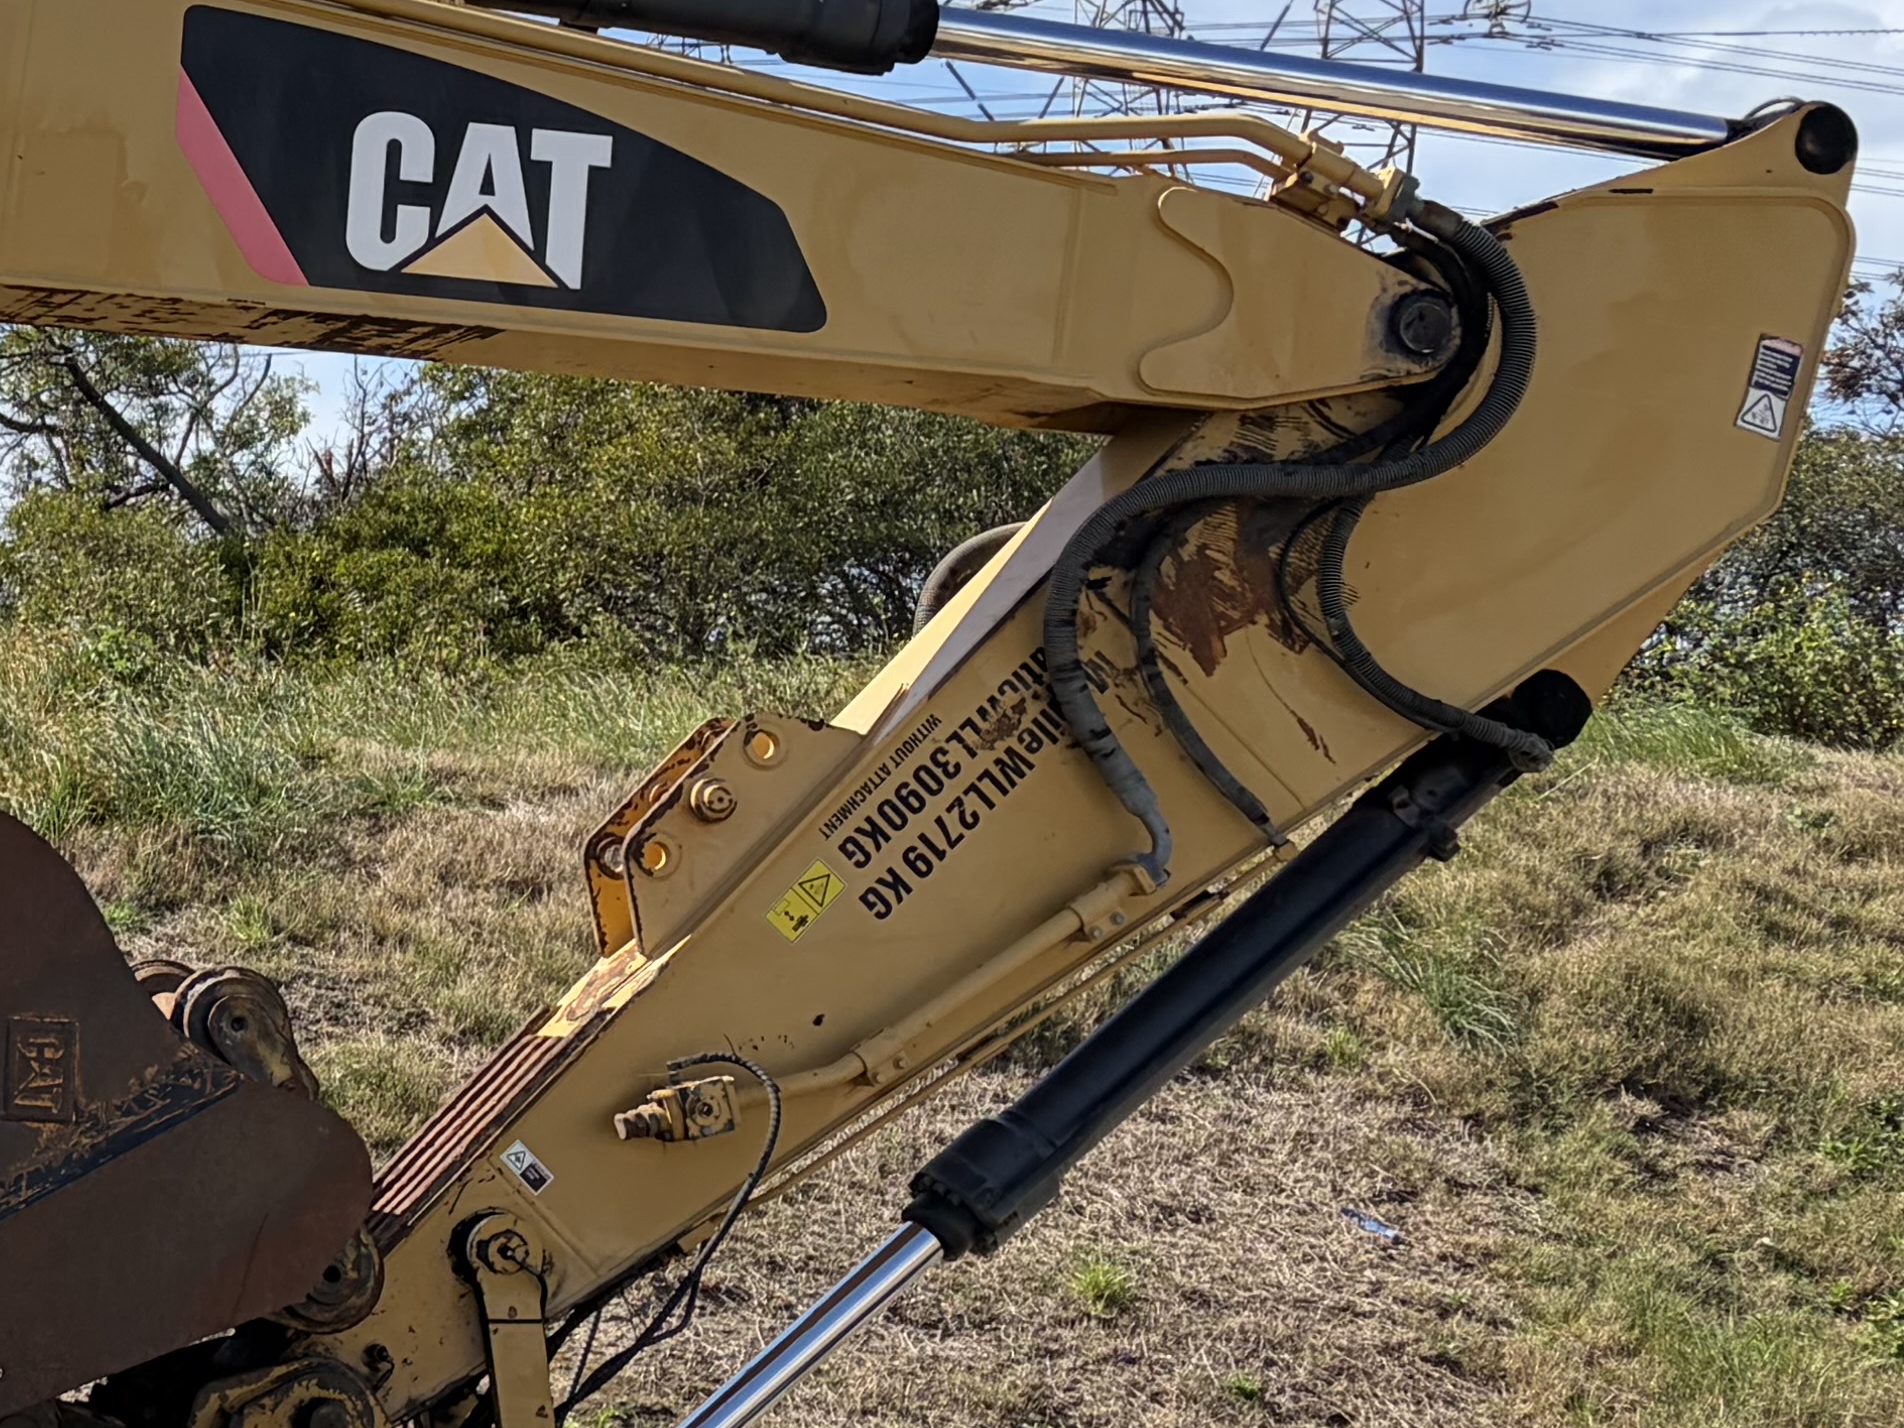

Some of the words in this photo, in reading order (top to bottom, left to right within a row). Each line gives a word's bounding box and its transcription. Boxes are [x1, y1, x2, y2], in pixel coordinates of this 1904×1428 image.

[345, 110, 613, 290] CAT
[888, 713, 942, 769] WITHOUT
[818, 762, 891, 840] ATTACHMENT
[14, 1037, 65, 1114] CAT
